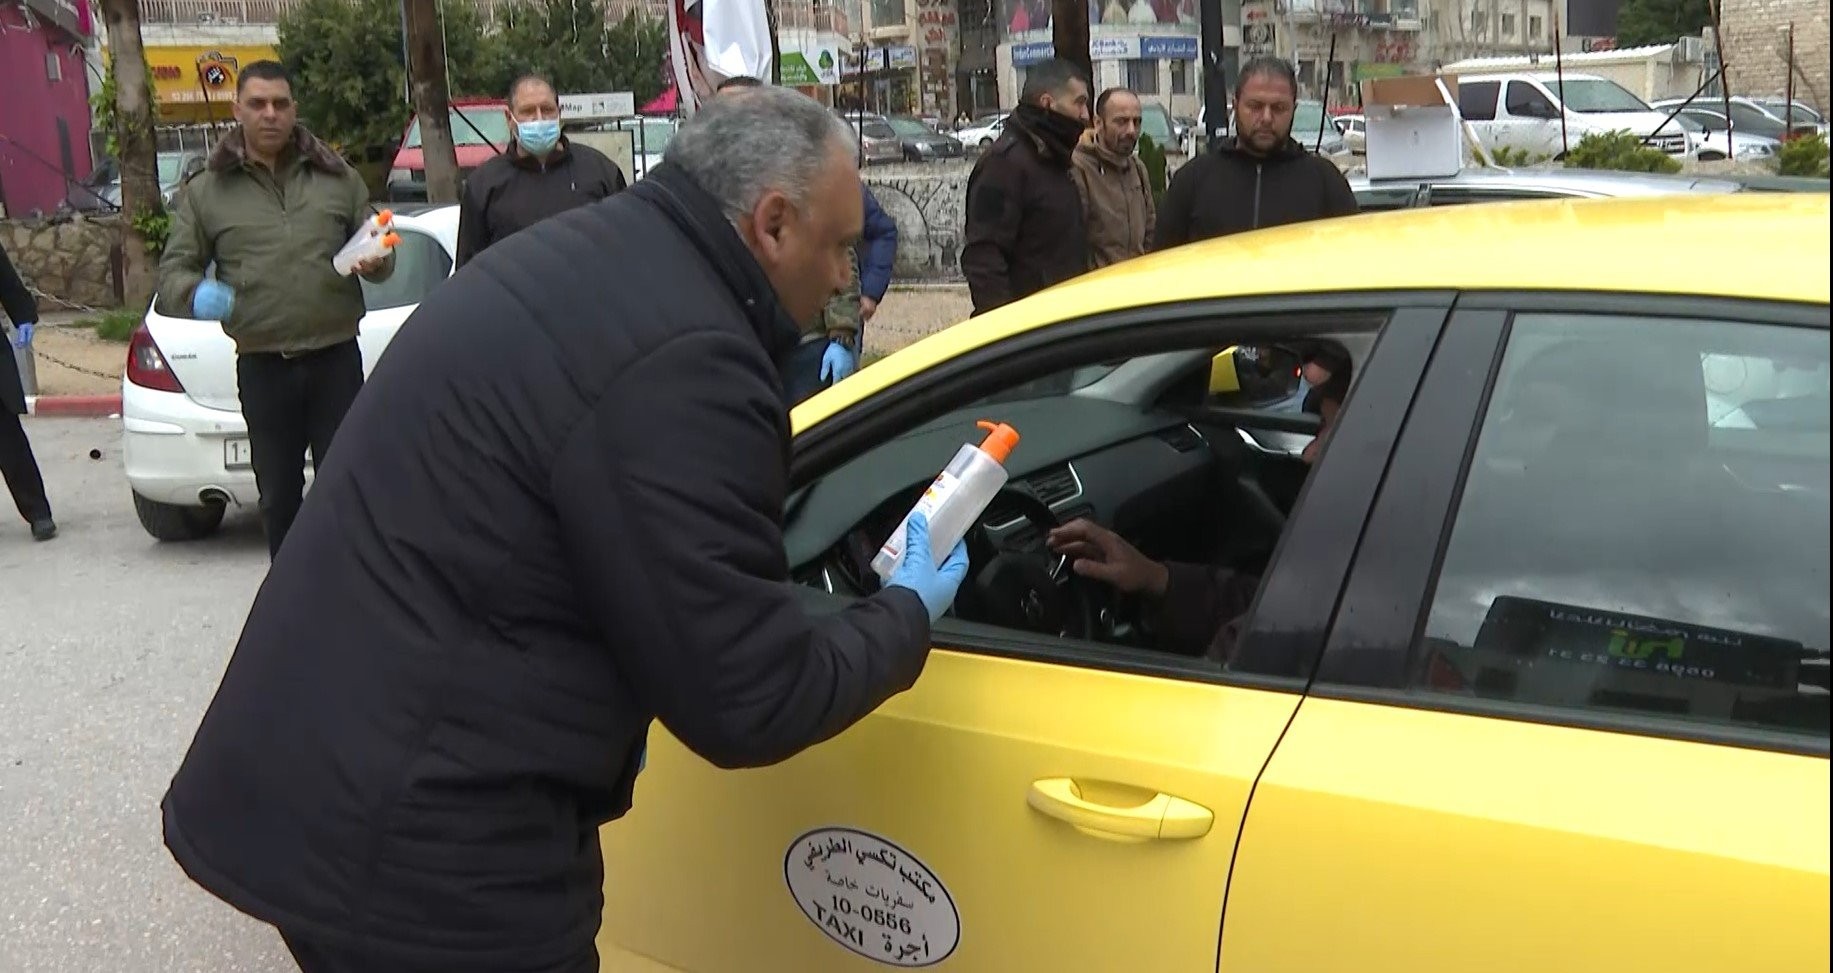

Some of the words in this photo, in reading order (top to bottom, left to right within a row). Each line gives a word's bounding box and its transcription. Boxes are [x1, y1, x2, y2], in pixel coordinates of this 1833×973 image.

[804, 837, 852, 871] الطريفي
[856, 848, 897, 871] تكسي
[825, 869, 859, 890] خاصة
[899, 866, 936, 904] مكتب
[865, 884, 914, 910] سفريات
[812, 899, 864, 947] TAXI
[831, 894, 912, 935] 10-0556
[882, 933, 930, 961] أجرة
